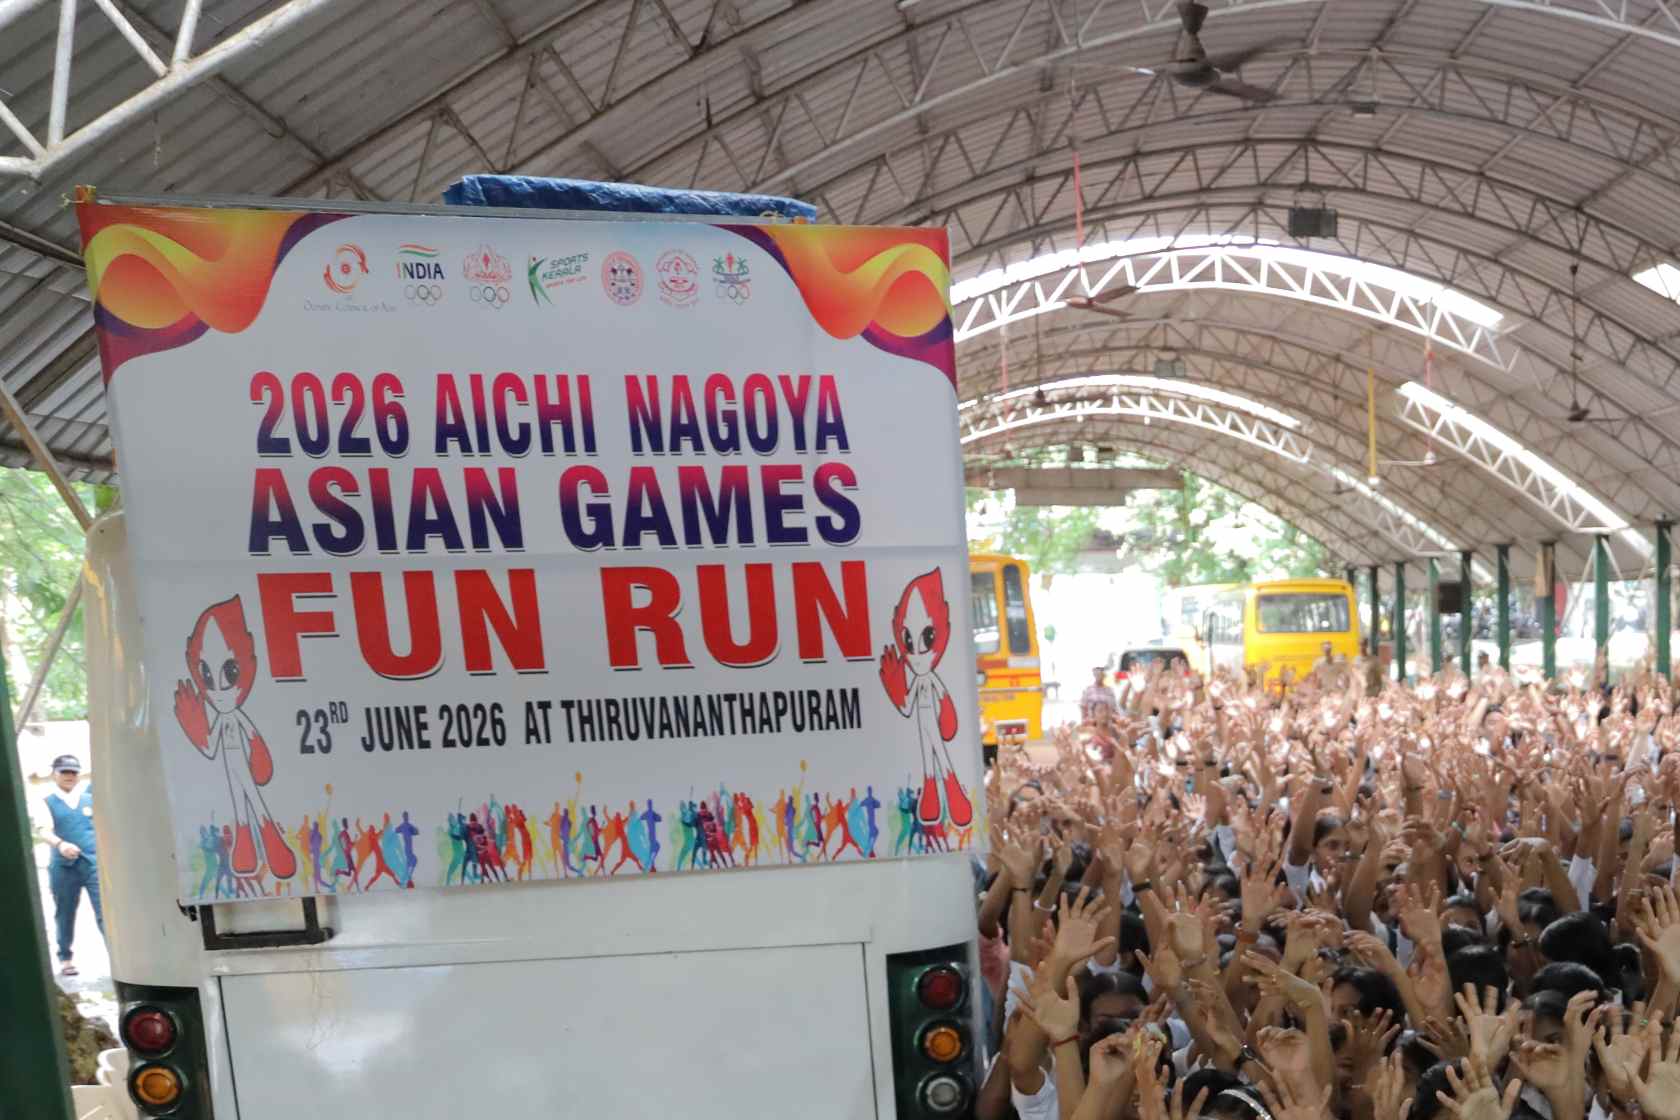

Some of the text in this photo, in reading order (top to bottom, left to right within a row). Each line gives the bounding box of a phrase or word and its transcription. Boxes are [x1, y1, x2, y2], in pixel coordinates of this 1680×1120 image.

[396, 262, 445, 280] INDIA
[550, 253, 589, 269] SPORTS
[250, 371, 853, 458] 2026 AICHI NAGOYA
[248, 462, 862, 557] ASIAN GAMES
[257, 561, 875, 682] FUN RUN
[296, 687, 863, 754] 23RD JUNE 2026 AT THIRUVANANTHAPURAM
